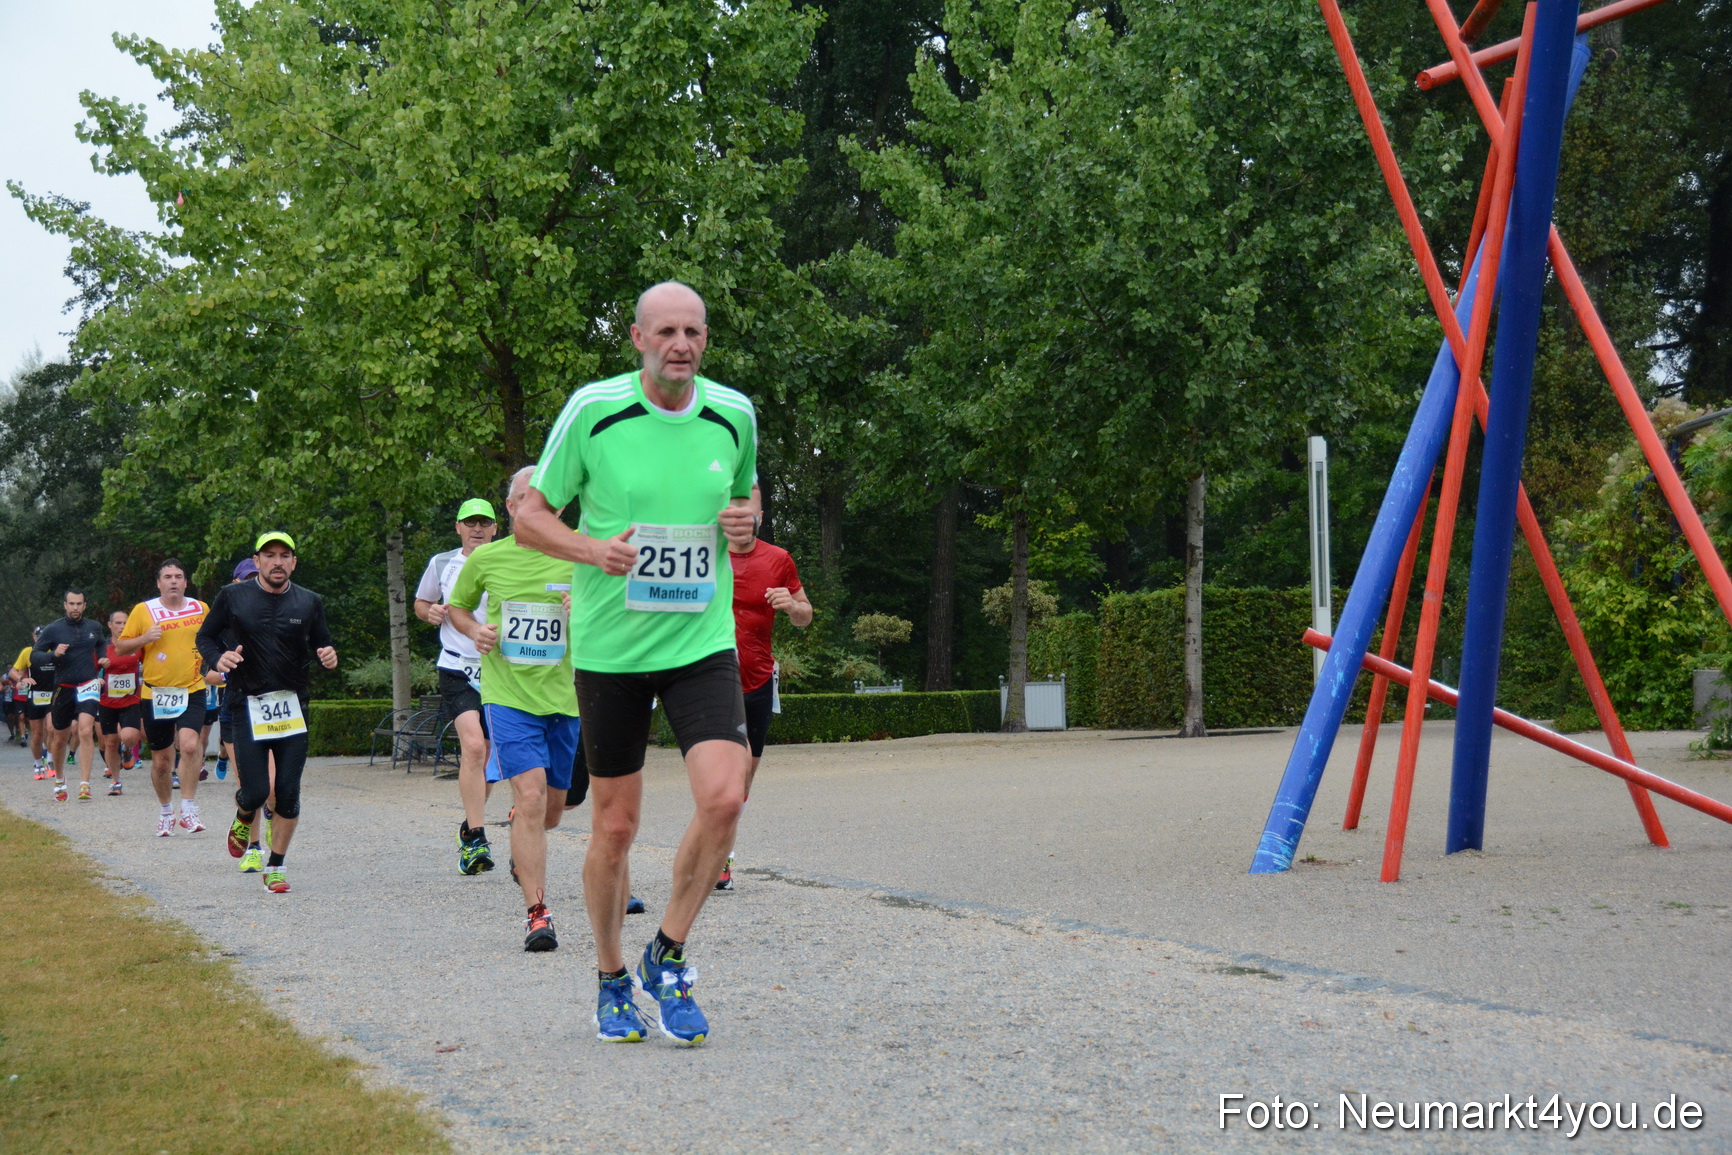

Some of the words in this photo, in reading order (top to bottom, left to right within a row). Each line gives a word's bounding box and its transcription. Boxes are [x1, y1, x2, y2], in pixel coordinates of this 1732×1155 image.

[638, 546, 709, 578] 2513
[649, 586, 698, 599] Manfred
[508, 617, 561, 641] 2759
[520, 646, 547, 657] Alfons
[113, 680, 131, 688] 298
[156, 694, 184, 706] 2781
[261, 700, 291, 721] 344
